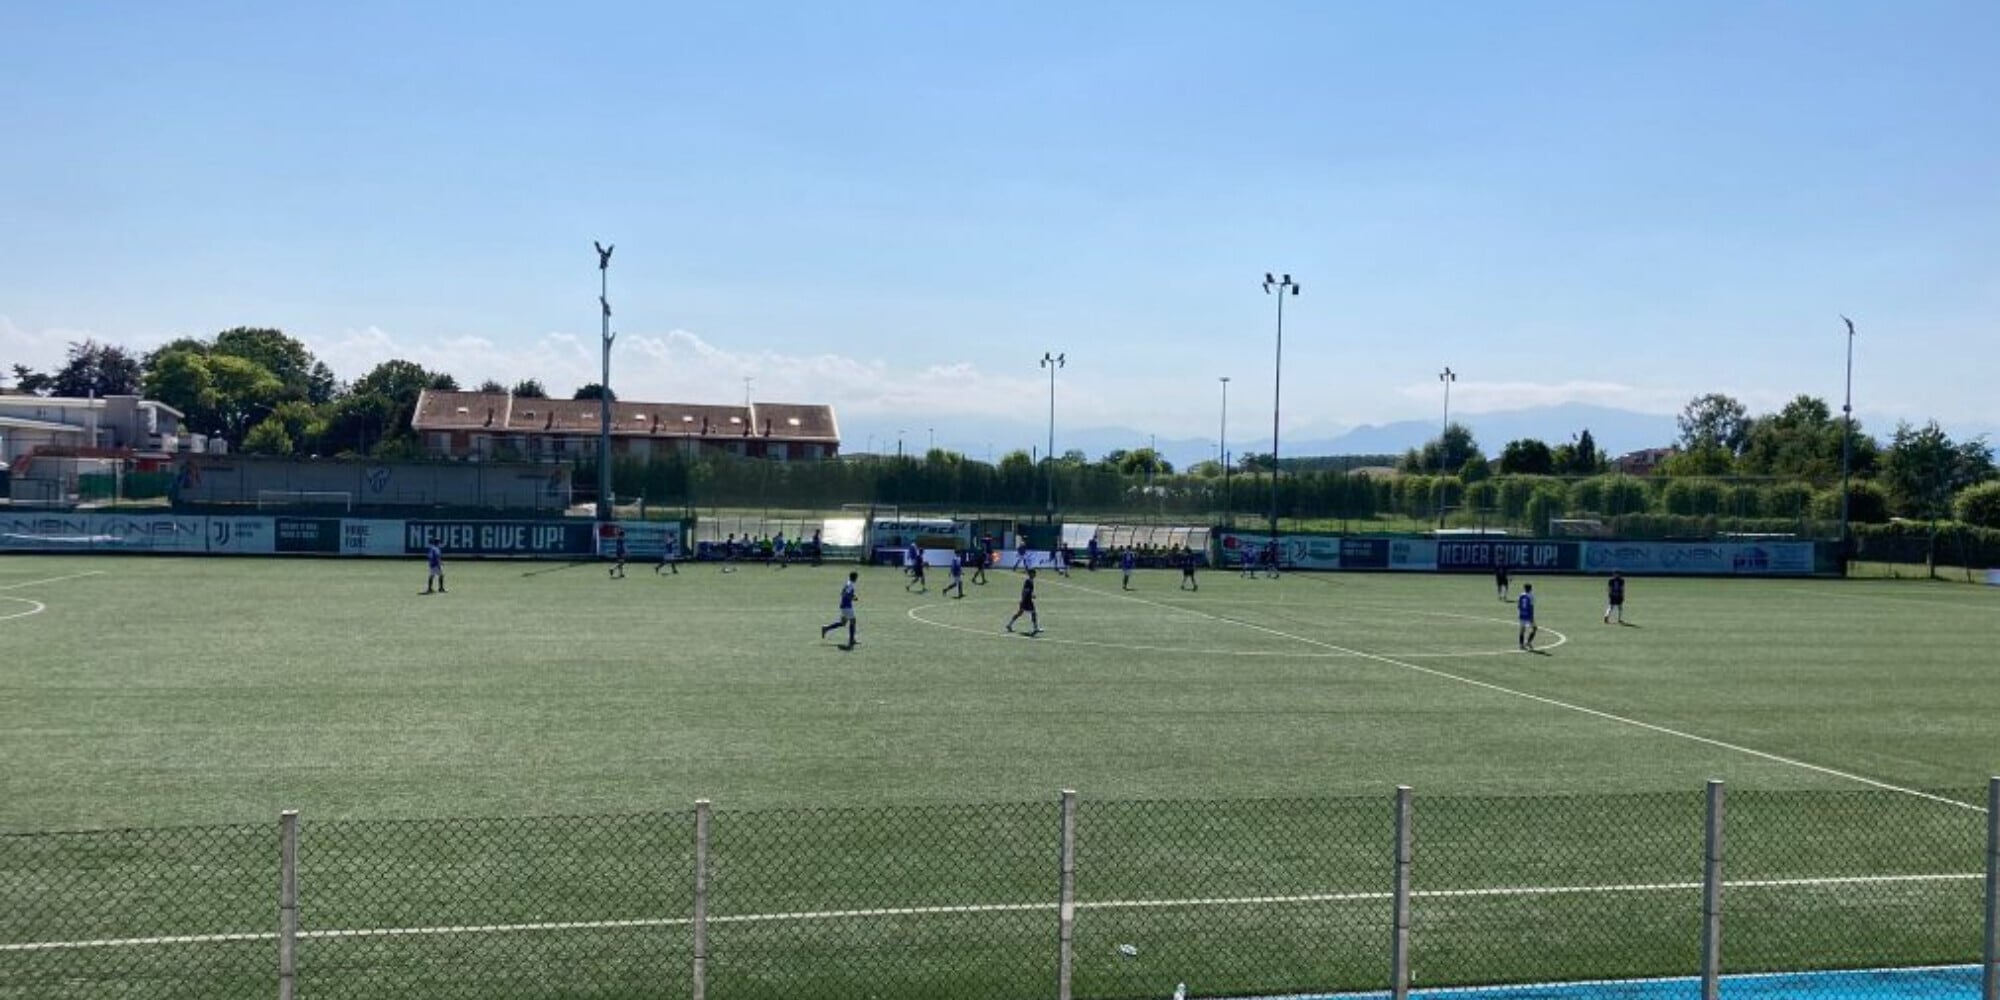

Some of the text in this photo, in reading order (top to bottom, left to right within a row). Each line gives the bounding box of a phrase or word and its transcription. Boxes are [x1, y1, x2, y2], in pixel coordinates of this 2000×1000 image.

[409, 525, 565, 550] NEVER GIVE UP!
[1440, 544, 1559, 567] NEVER GIVE UP!
